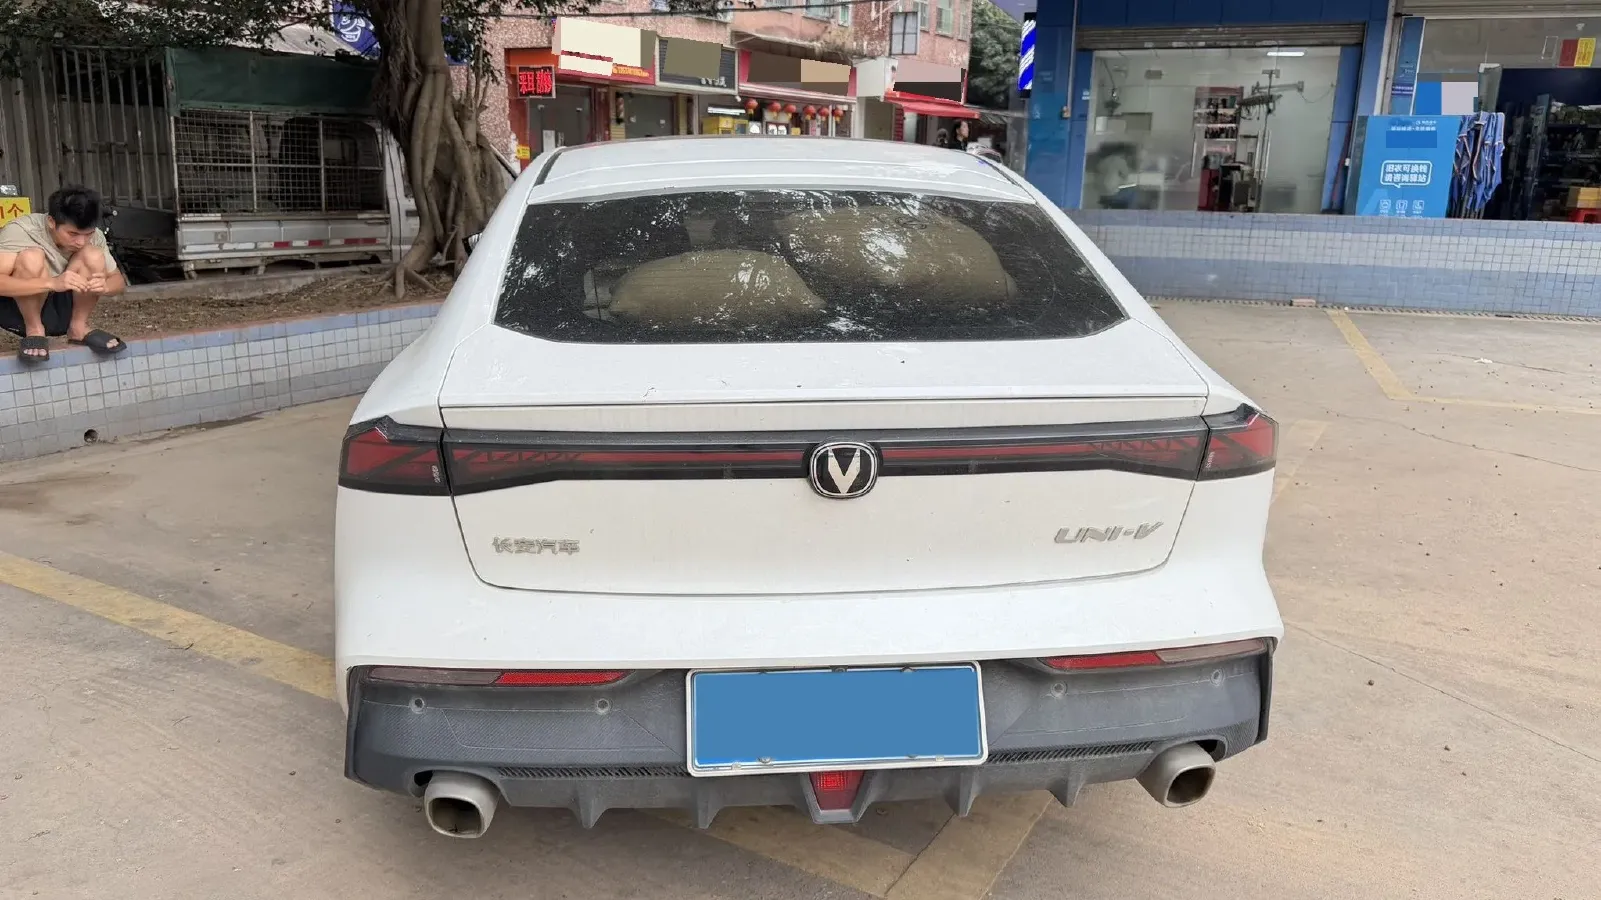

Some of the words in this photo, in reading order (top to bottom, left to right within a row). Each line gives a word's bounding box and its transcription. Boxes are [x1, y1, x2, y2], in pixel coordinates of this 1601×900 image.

[1054, 521, 1164, 544] UNI-V
[492, 537, 580, 555] 长安汽车
